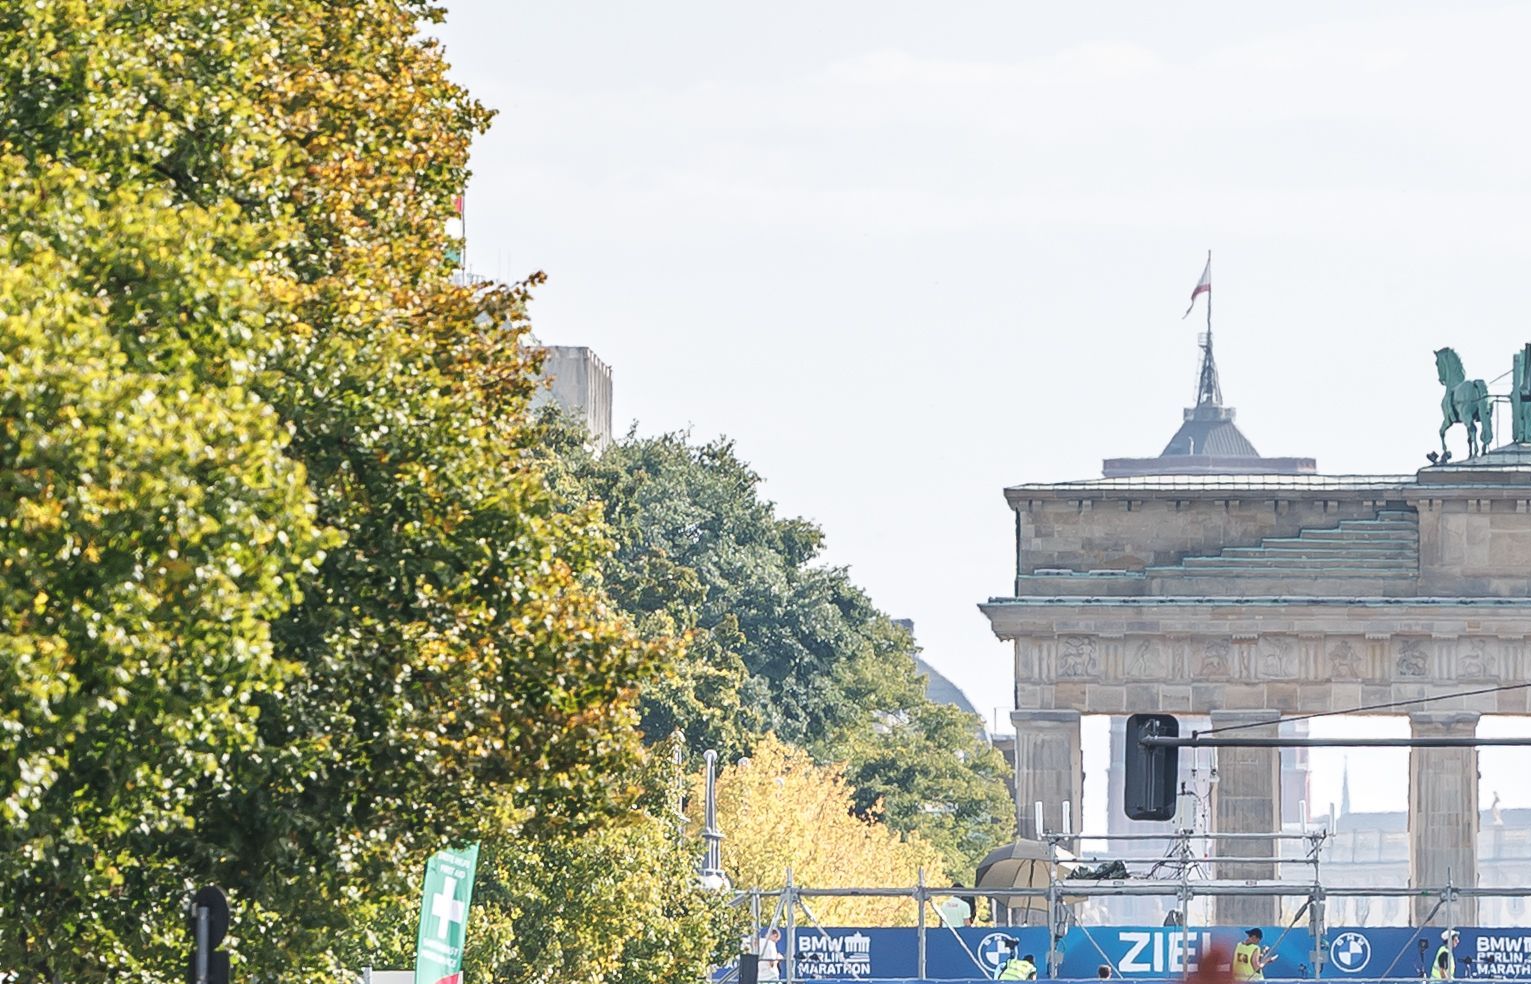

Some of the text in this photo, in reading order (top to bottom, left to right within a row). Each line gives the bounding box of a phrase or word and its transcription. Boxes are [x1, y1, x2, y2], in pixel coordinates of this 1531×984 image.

[798, 936, 844, 951] BMW
[1477, 936, 1523, 952] BMW
[797, 963, 871, 975] MARATHON
